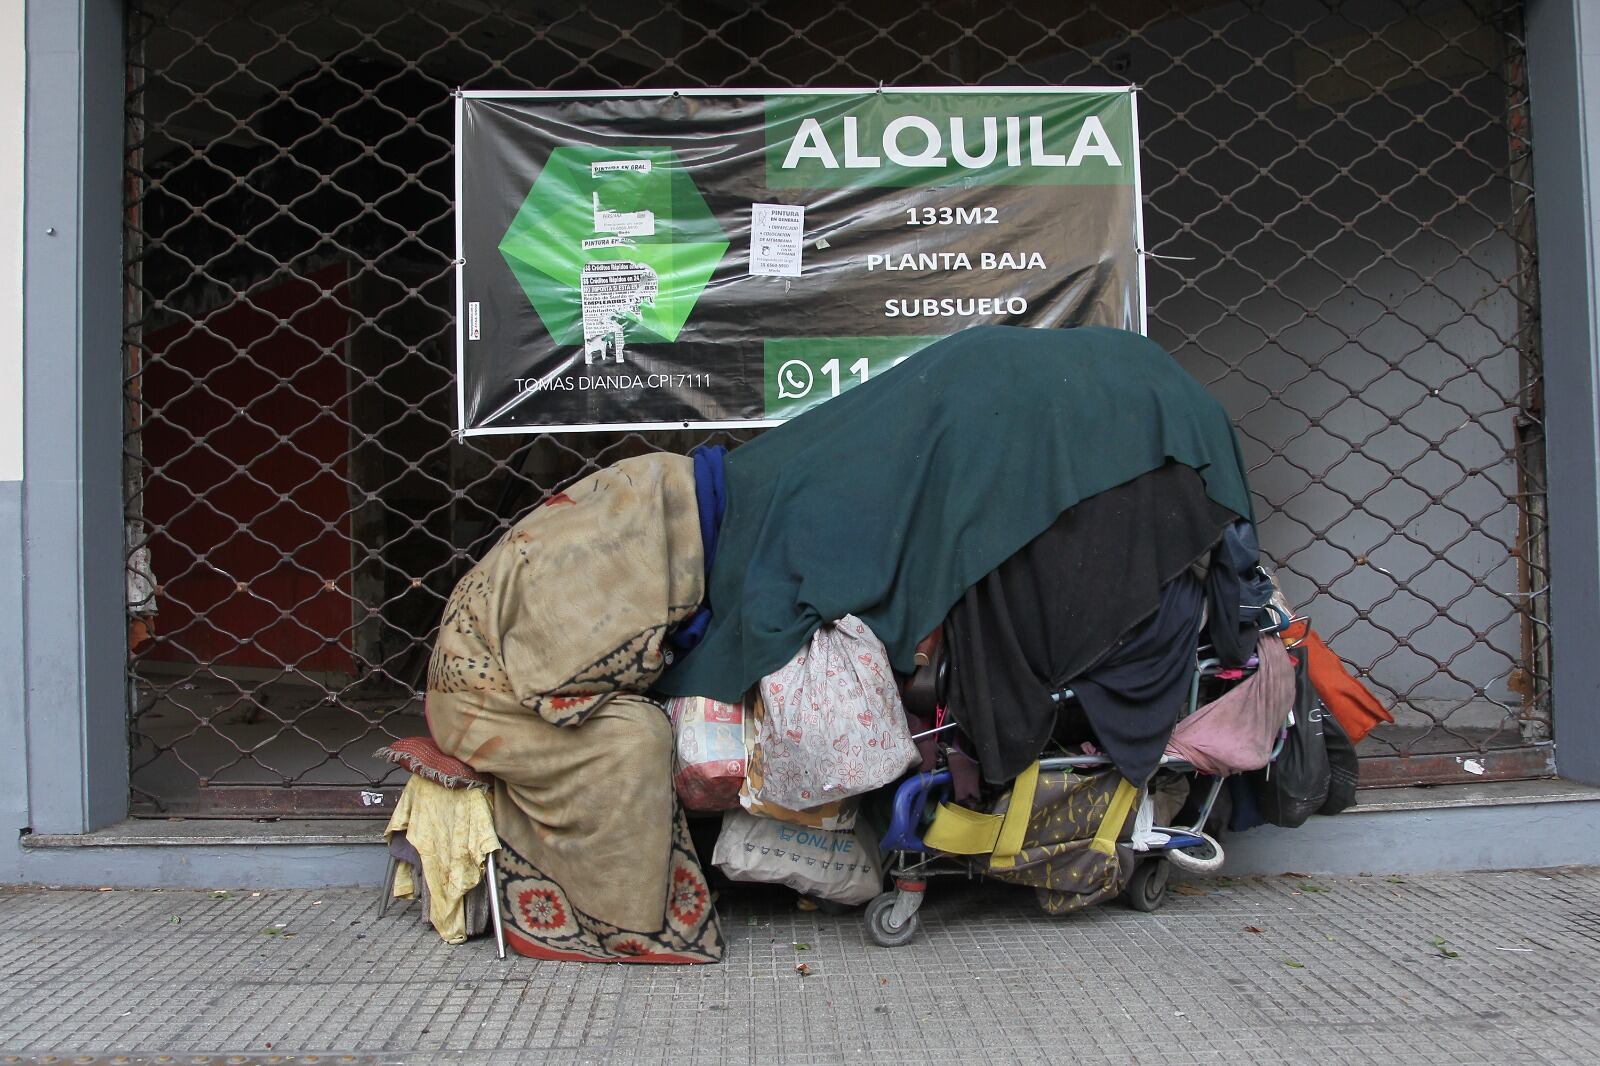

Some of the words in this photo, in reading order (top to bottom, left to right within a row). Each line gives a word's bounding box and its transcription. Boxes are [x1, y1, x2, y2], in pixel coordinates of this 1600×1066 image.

[781, 115, 1123, 169] ALQUILA
[905, 206, 1000, 225] 133M2
[584, 239, 610, 247] PINTURA
[866, 252, 974, 271] PLANTA
[980, 252, 1047, 270] BAJA
[884, 295, 1029, 317] SUBSUELO
[514, 376, 575, 393] TOMAS
[578, 375, 644, 391] DIANDA
[647, 374, 673, 389] CPI
[676, 373, 711, 388] 7111
[796, 830, 855, 853] ONLNE
